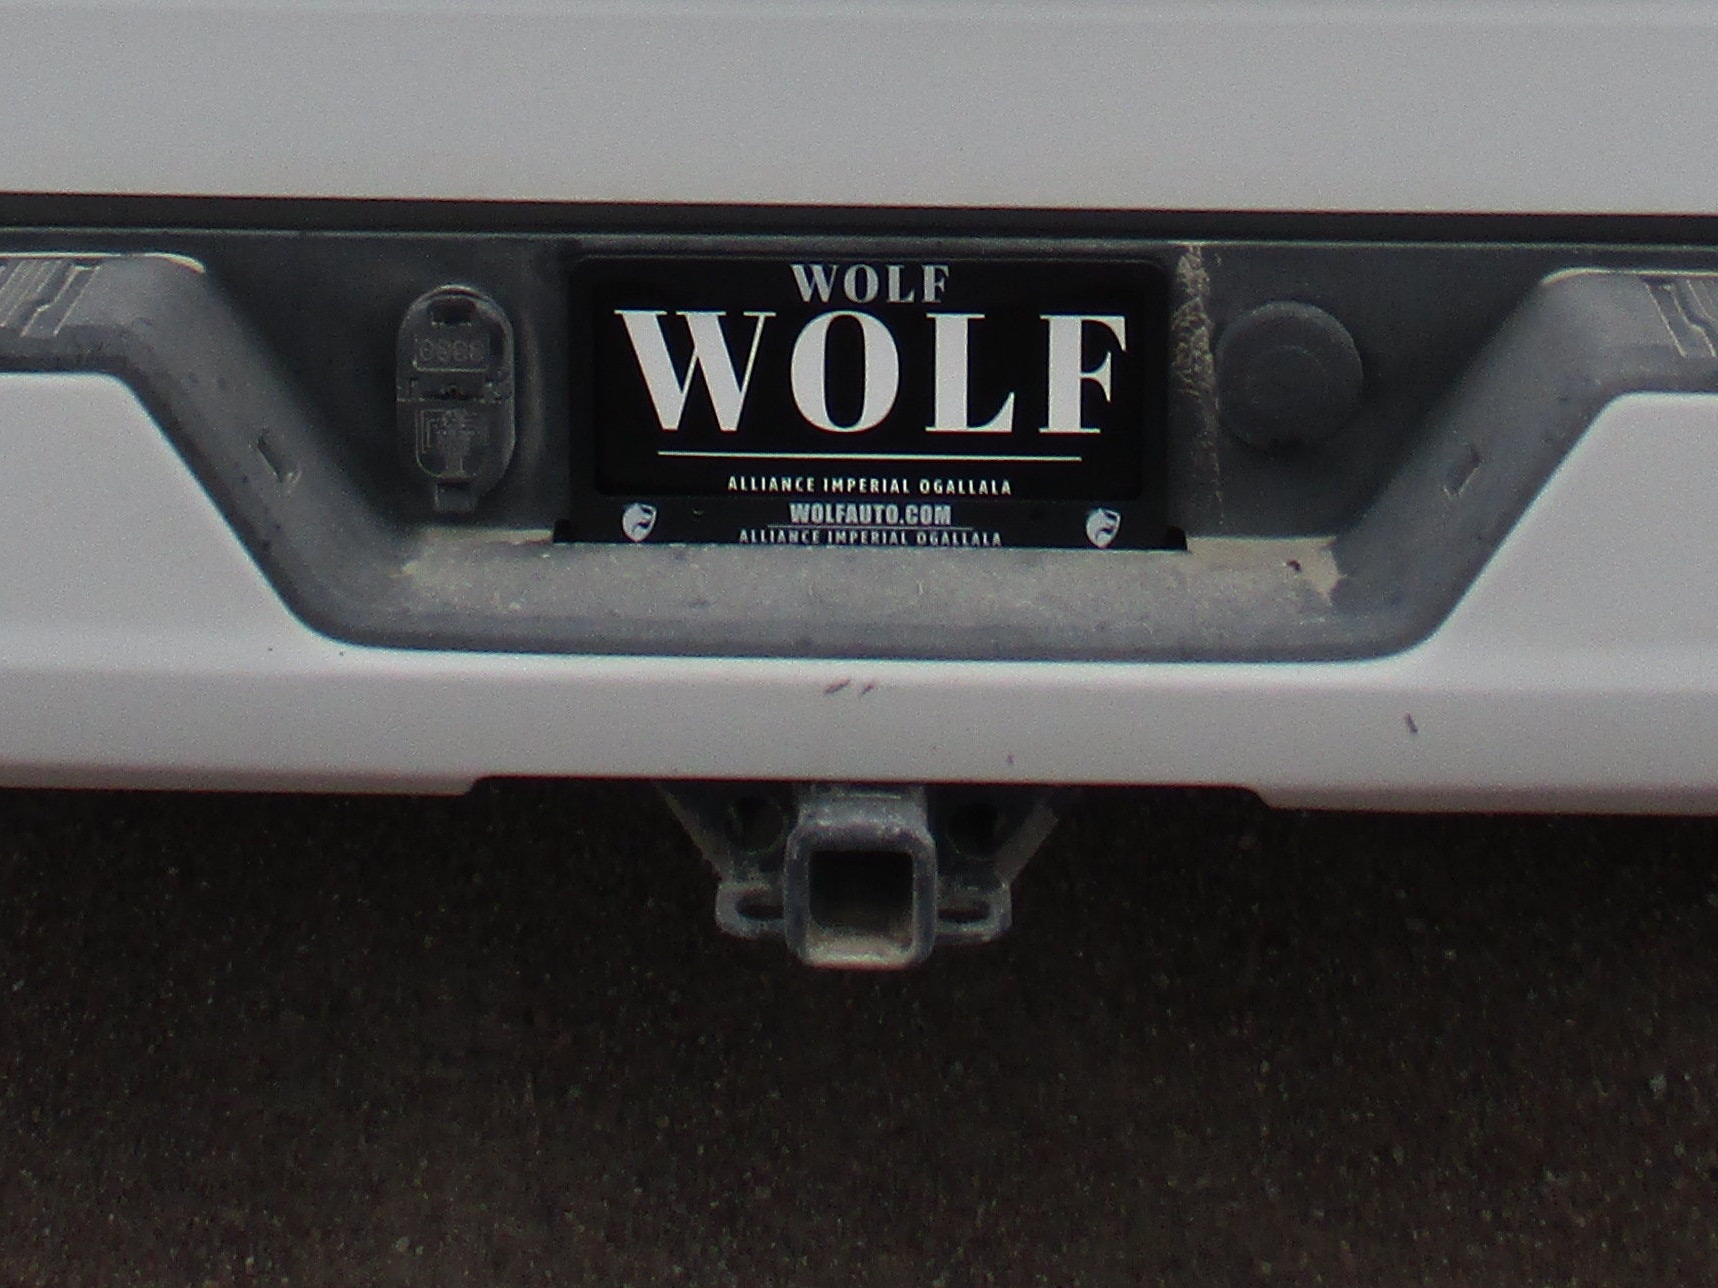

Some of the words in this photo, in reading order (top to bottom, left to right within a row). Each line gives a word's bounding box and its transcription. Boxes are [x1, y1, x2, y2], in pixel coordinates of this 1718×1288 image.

[790, 263, 950, 304] WOLF
[614, 309, 1127, 434] WOLF
[728, 475, 815, 492] ALLIANCE
[823, 477, 910, 494] IMPERIAL
[919, 478, 1011, 495] OGALLALA
[789, 503, 952, 525] WOLFAUTO.COM
[739, 529, 820, 544] ALLIANCE
[827, 530, 907, 545] IMPERIAL
[916, 531, 1002, 547] OGALLALA
